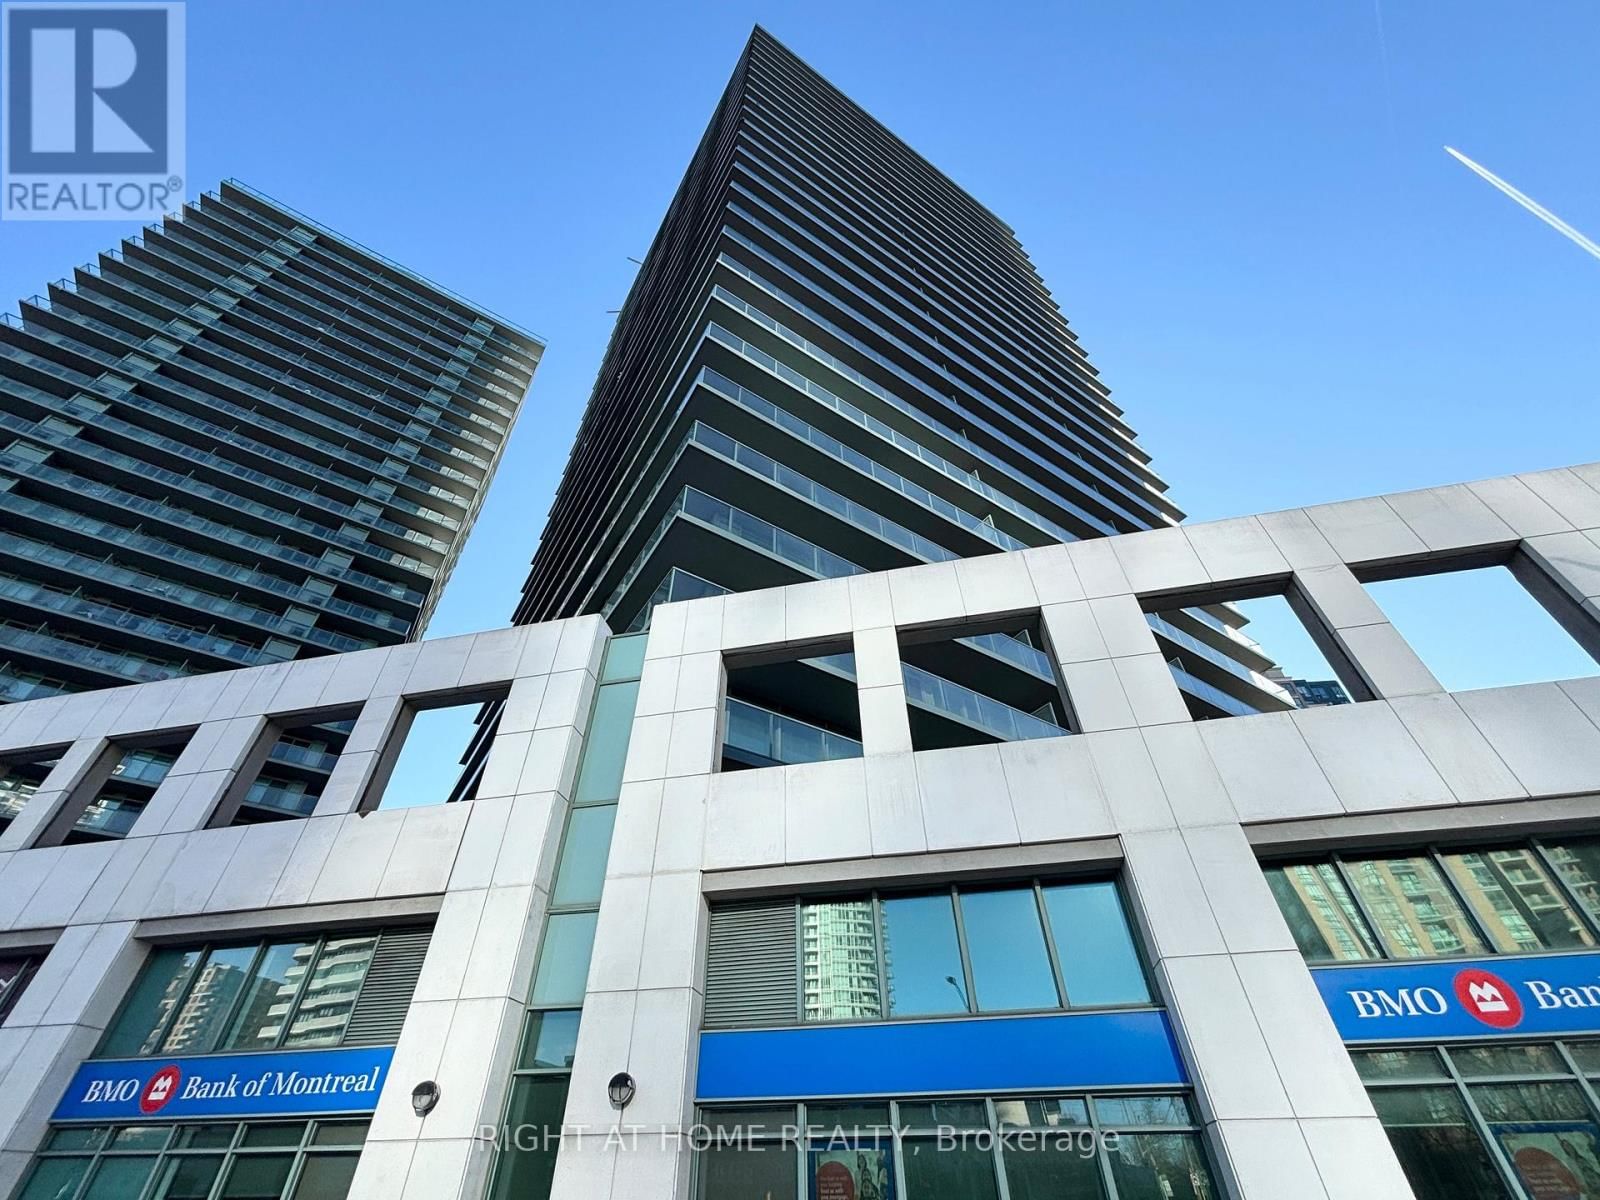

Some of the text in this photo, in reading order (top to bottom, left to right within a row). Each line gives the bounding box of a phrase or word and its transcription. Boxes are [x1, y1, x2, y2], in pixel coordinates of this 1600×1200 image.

[1347, 976, 1600, 1018] BMO Ban
[81, 1066, 380, 1103] BMO Bank of Montreal
